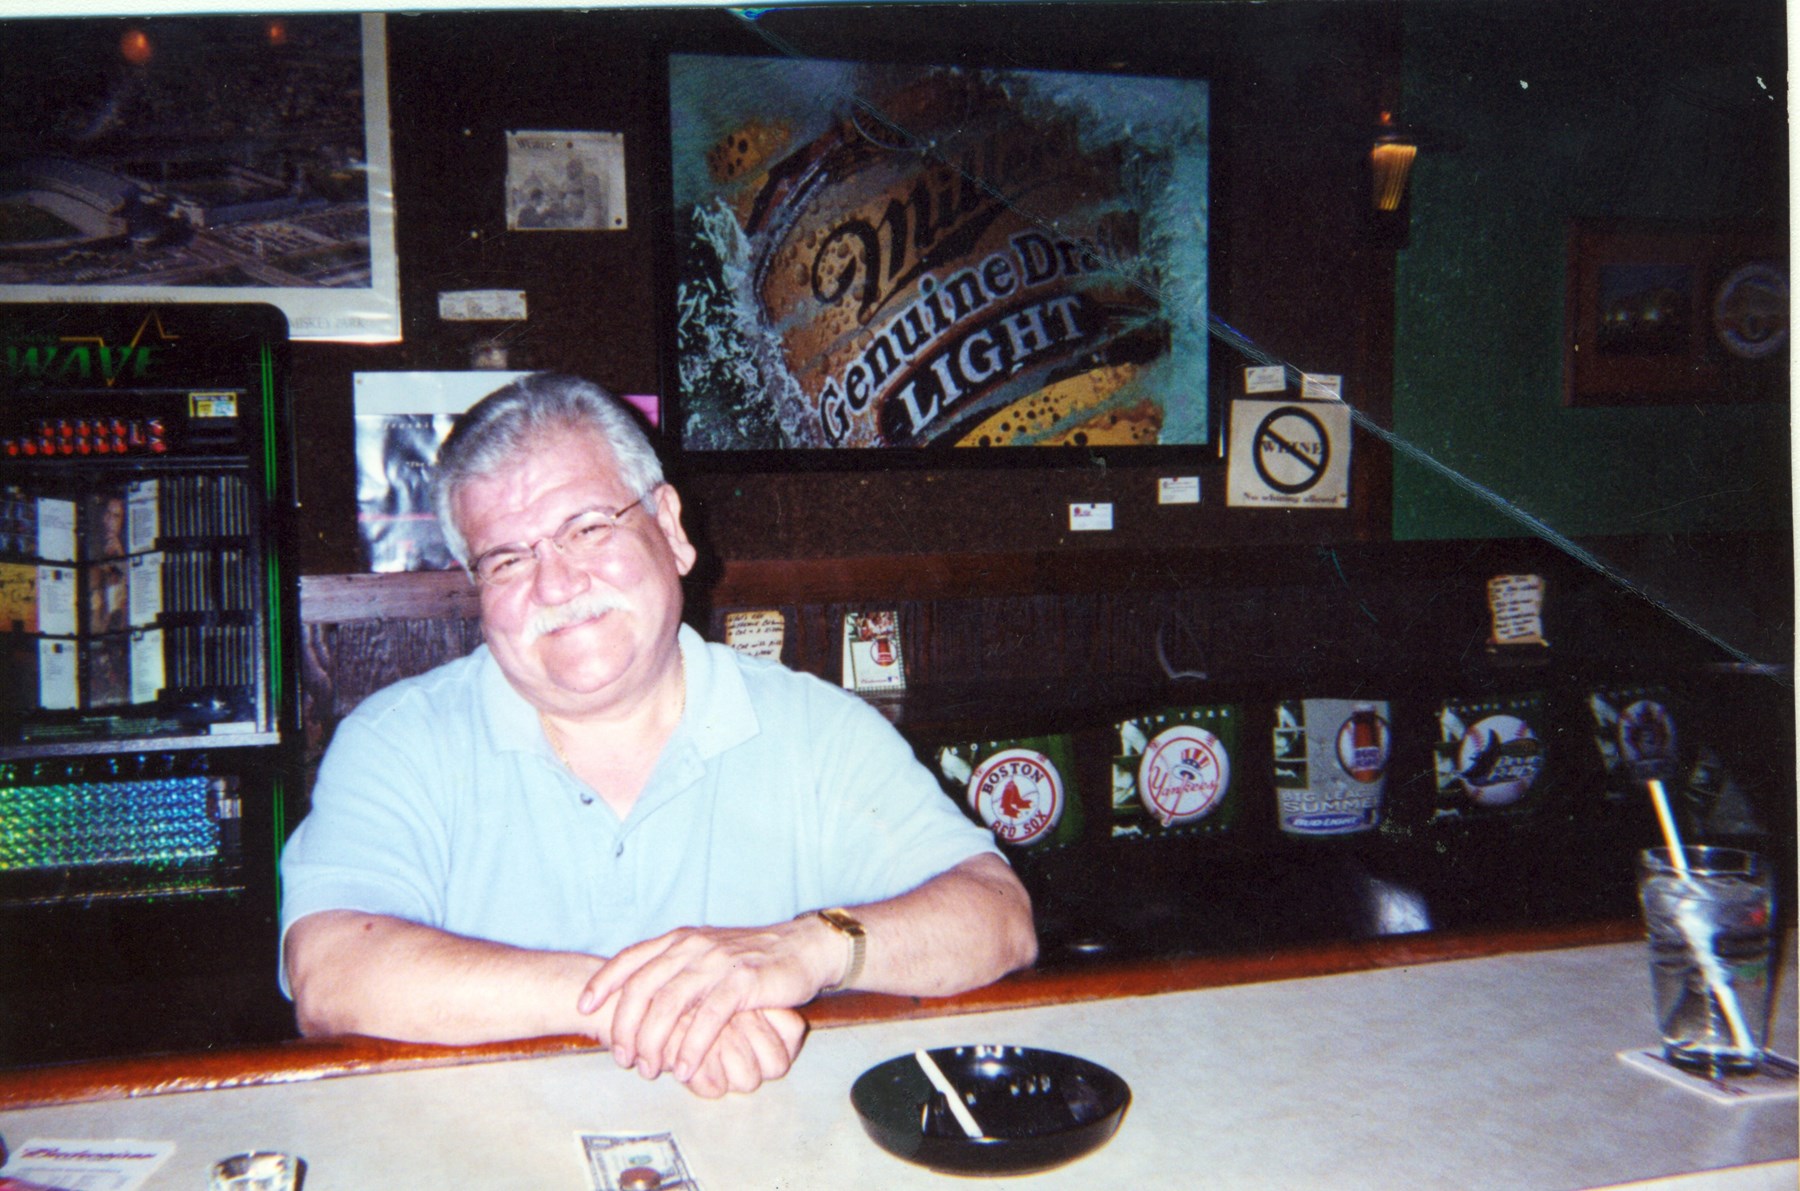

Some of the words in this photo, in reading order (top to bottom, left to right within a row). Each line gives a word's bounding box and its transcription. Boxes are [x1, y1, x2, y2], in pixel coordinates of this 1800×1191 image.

[6, 346, 164, 378] WAVE
[817, 253, 1016, 446] Genuine
[896, 295, 1087, 435] LIGHT
[981, 762, 1045, 797] BOSTON
[1151, 765, 1218, 802] Yankees
[991, 819, 1017, 839] RED
[1022, 809, 1048, 835] SOX
[1293, 817, 1322, 828] BUD
